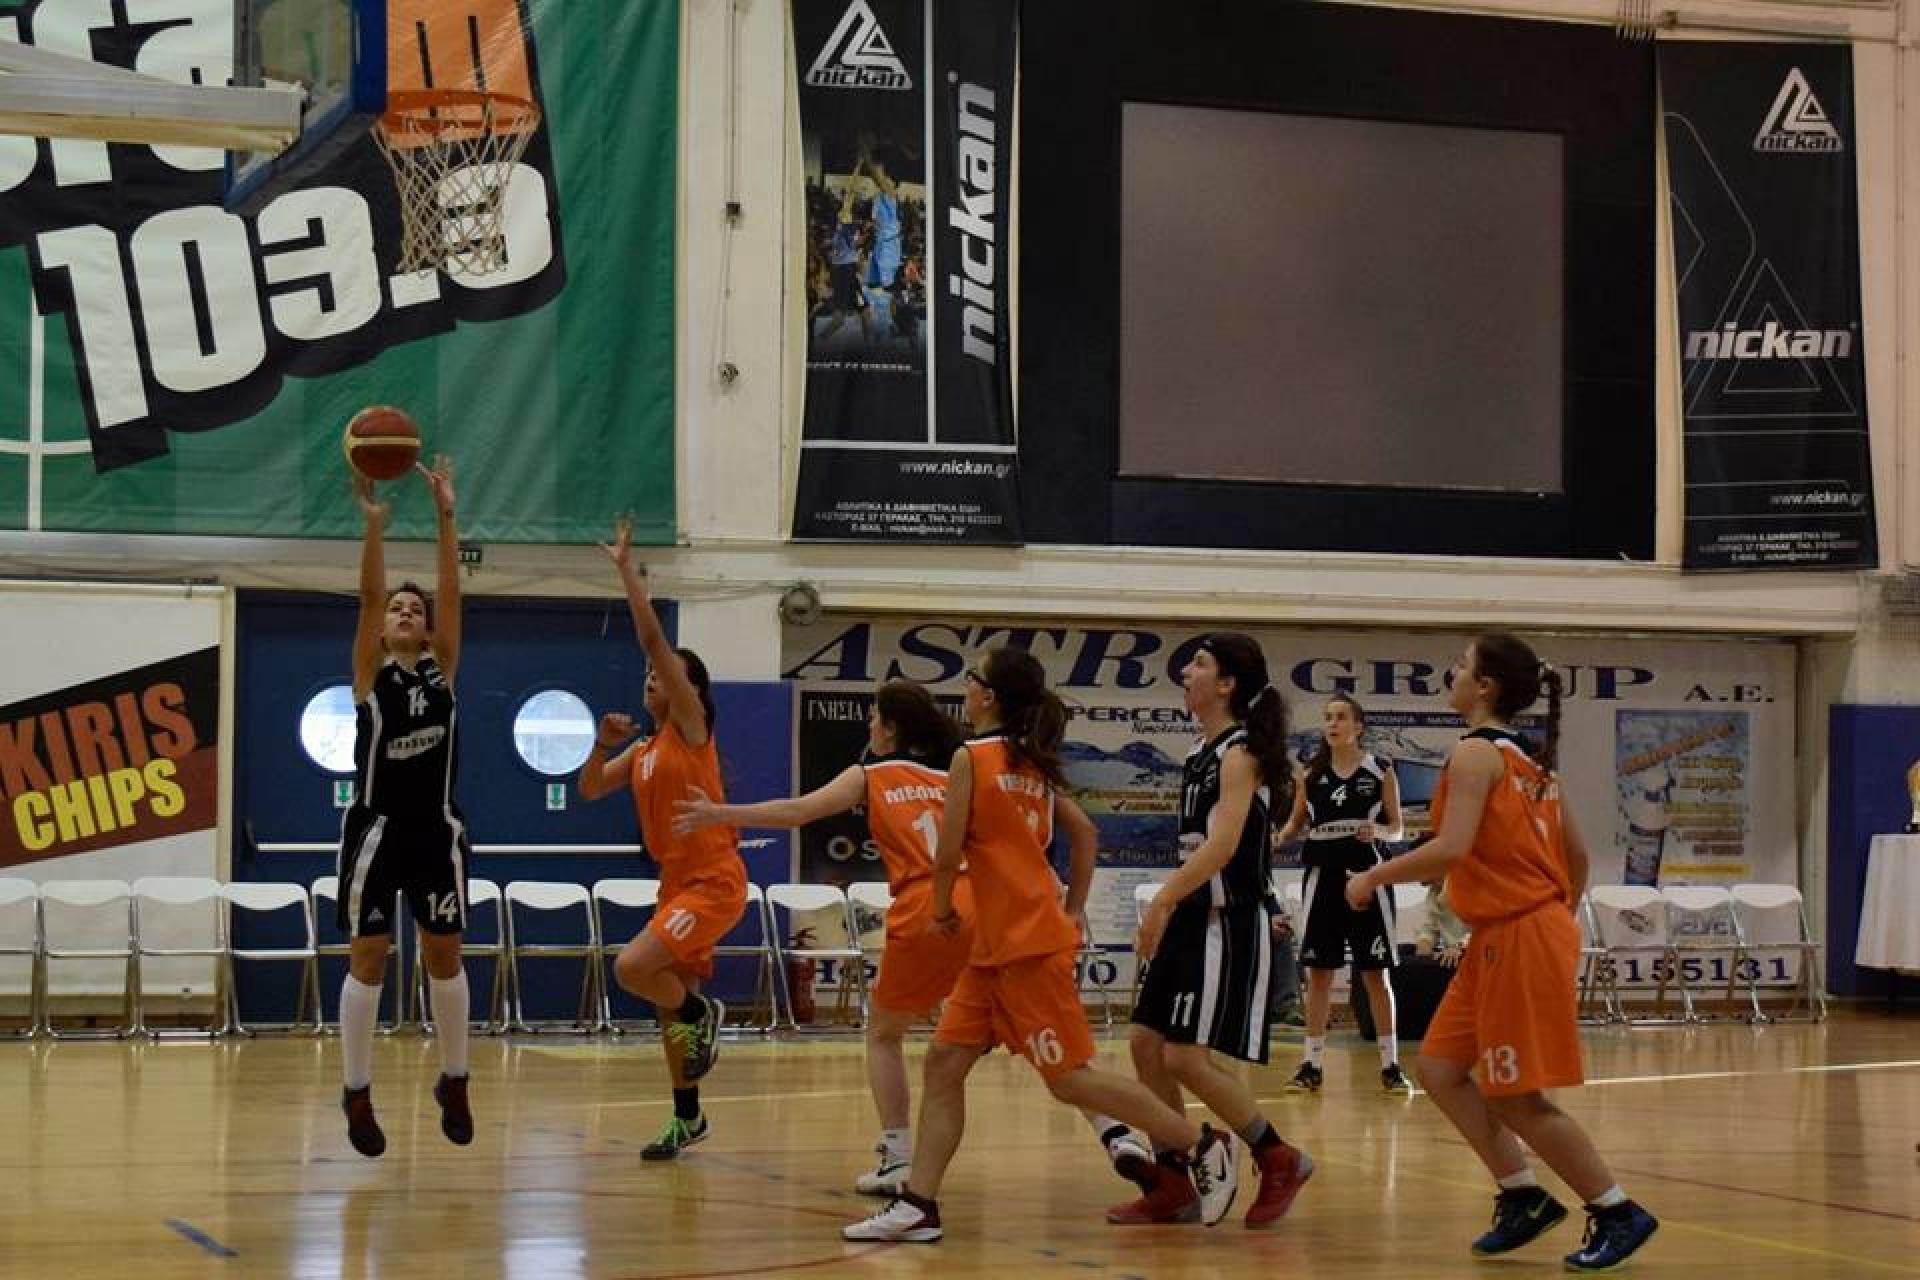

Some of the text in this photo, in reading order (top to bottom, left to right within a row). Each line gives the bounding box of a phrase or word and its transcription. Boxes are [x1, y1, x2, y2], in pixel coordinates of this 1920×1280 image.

[950, 82, 996, 366] nickan
[1684, 321, 1851, 359] nickan
[1290, 657, 1655, 701] GRUP
[1684, 684, 1775, 703] A.E.
[407, 685, 430, 717] 14
[1064, 706, 1193, 723] PERCEN
[0, 682, 198, 798] KIRIS
[13, 758, 187, 851] CHIPS
[1330, 783, 1348, 807] 4
[911, 807, 940, 862] 1
[427, 891, 459, 923] 14
[664, 908, 697, 941] 10
[1370, 935, 1387, 961] 4
[1170, 991, 1196, 1027] 11
[1025, 1027, 1064, 1067] 16
[1484, 1044, 1521, 1086] 13
